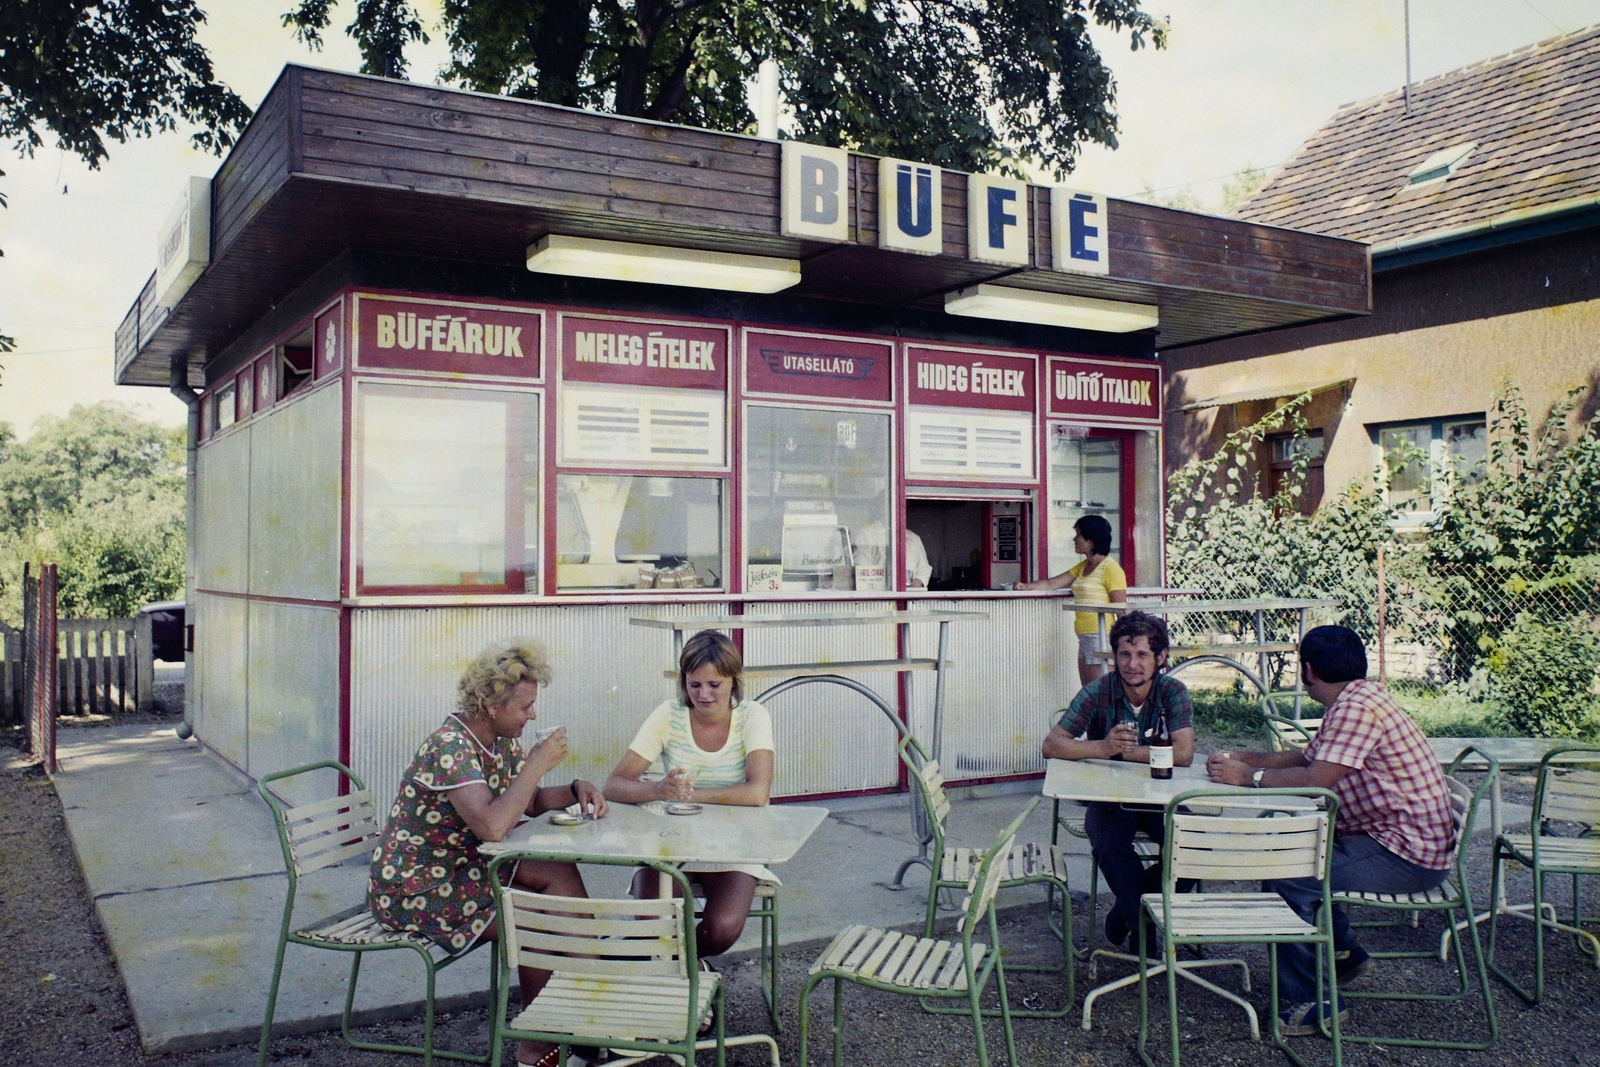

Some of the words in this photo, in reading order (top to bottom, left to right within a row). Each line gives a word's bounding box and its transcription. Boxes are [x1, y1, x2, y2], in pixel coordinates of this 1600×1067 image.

[800, 154, 1099, 262] BÜFÉ
[376, 311, 523, 358] BÜFÉÁRUK
[575, 332, 643, 366] MELEG
[646, 331, 715, 371] ÉTELEK
[783, 355, 854, 374] UTASELLÁTÓ
[917, 362, 968, 392] HIDEG
[971, 362, 1025, 397] ÉTELEK
[1055, 369, 1104, 402] ÜDÍTŐ
[1102, 377, 1152, 406] ITALOK
